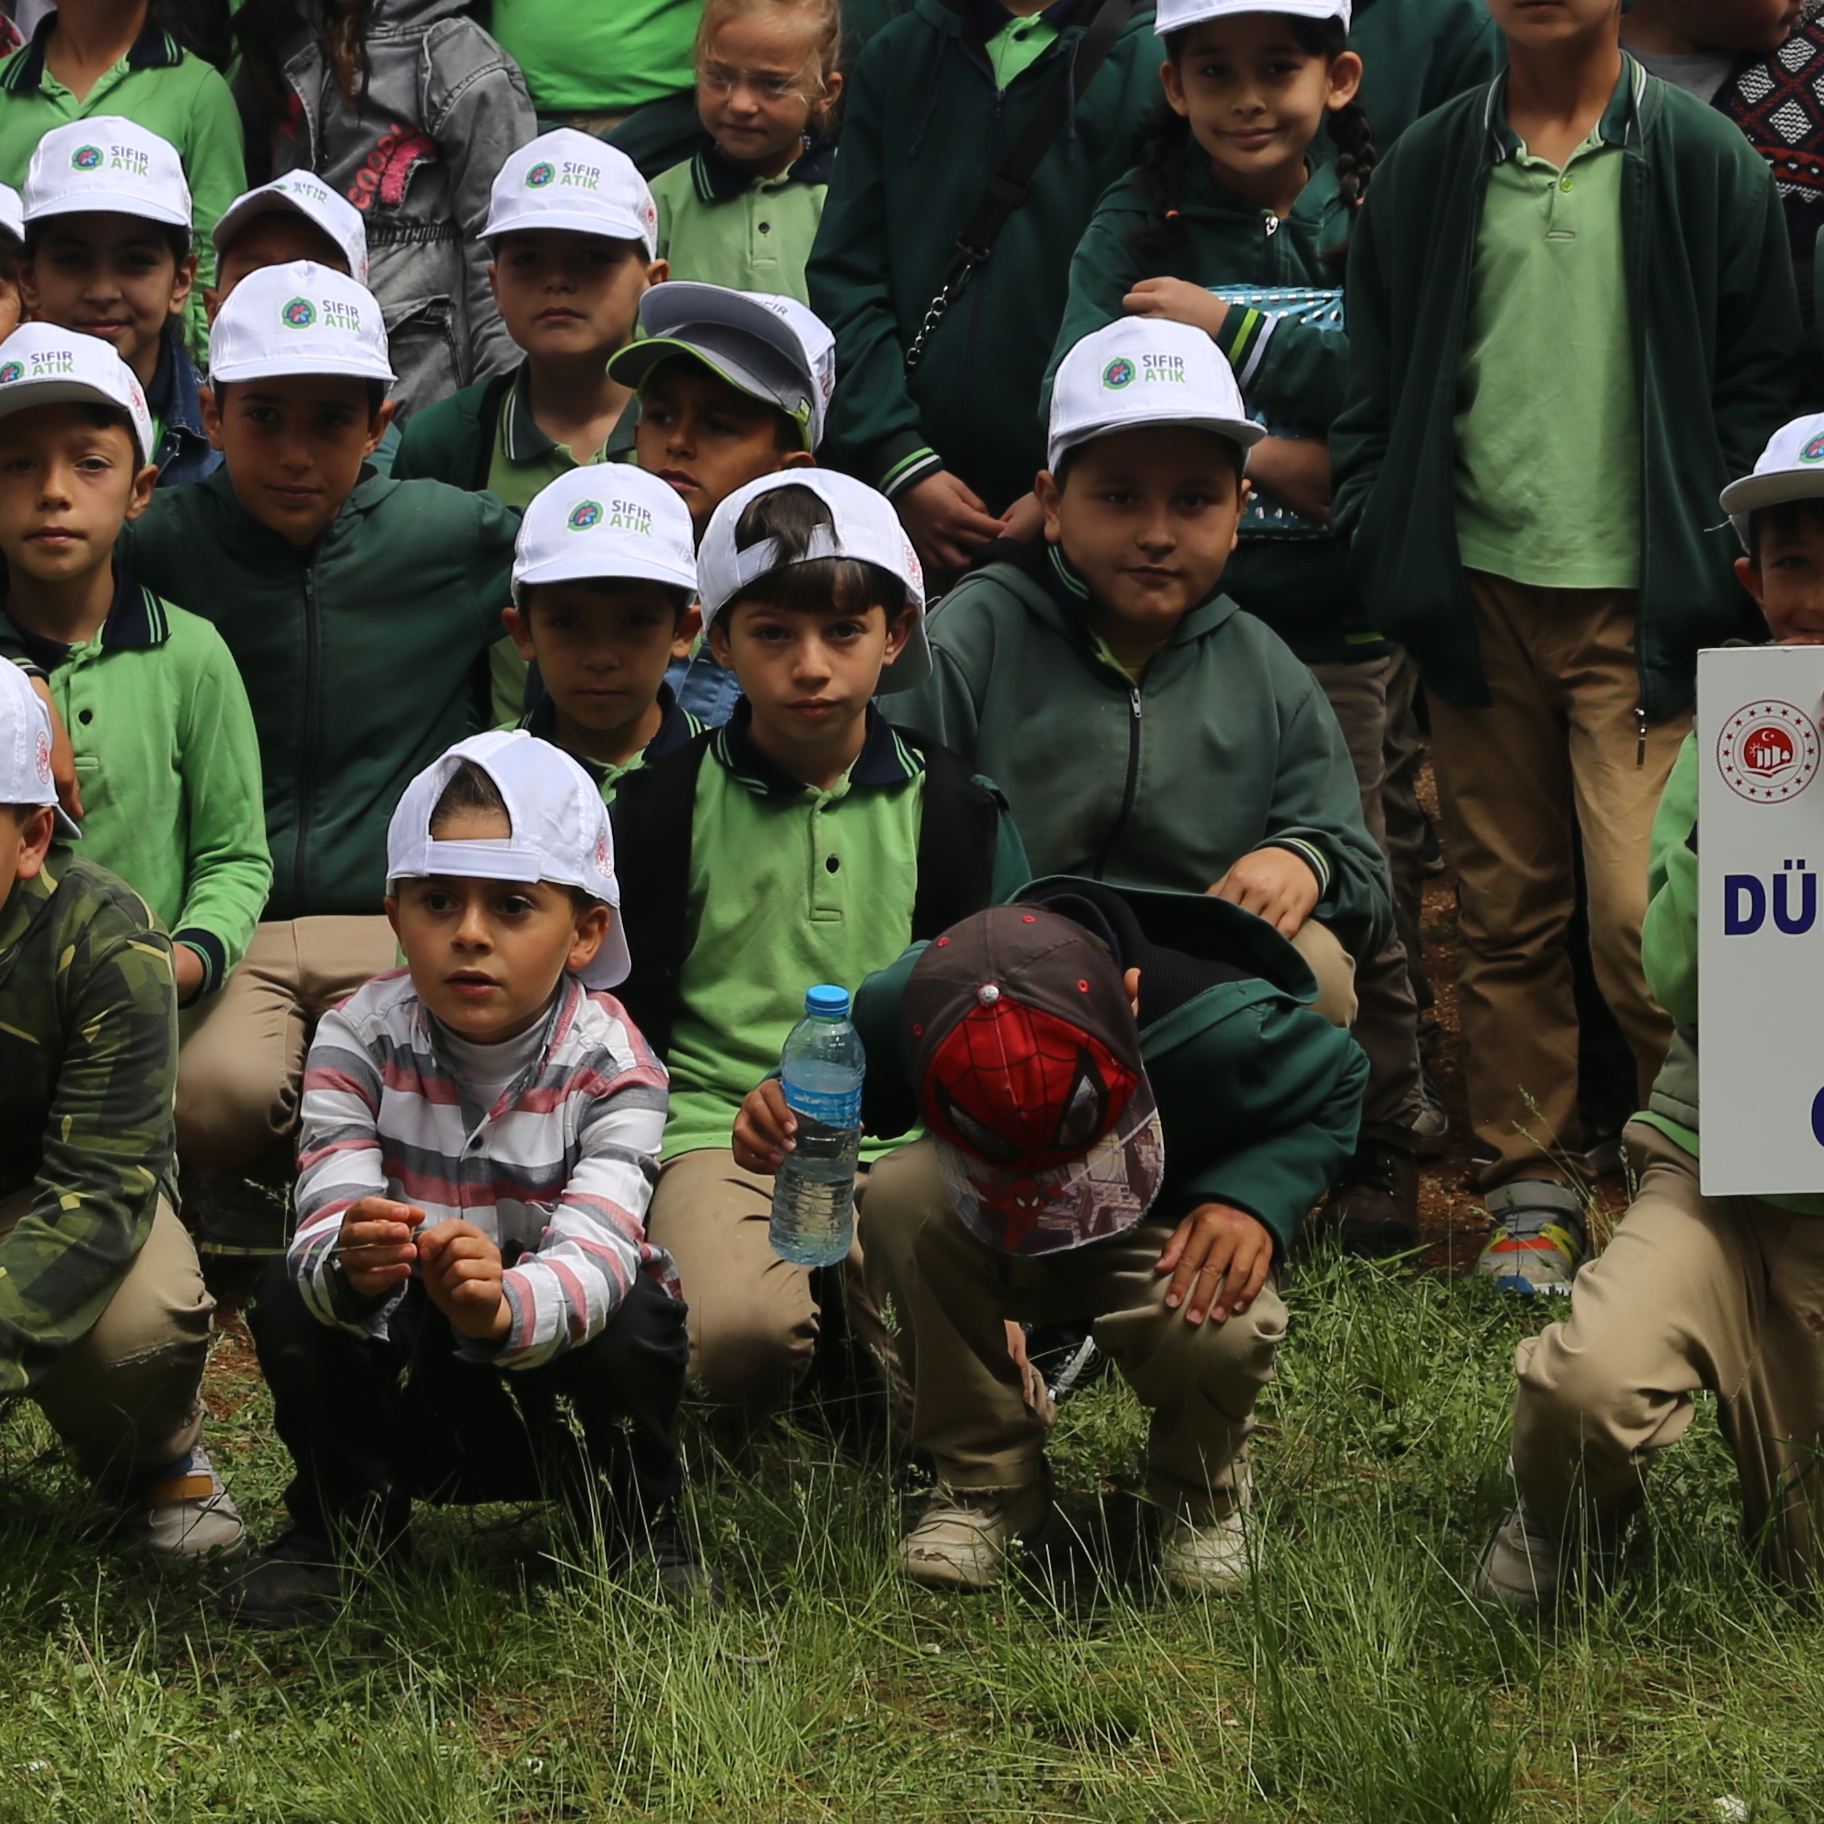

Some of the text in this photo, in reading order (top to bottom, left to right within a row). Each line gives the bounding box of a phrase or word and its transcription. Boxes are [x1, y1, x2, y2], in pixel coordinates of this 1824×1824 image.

[111, 145, 149, 164] SIFIR
[111, 158, 149, 176] ATIK
[563, 161, 600, 178] SIFIR
[562, 174, 598, 191] ATIK
[323, 300, 359, 318] SIFIR
[325, 314, 362, 333] ATIK
[31, 351, 72, 364] SIFIR
[1143, 354, 1184, 369] SIFIR
[33, 362, 74, 376] ATIK
[1145, 368, 1185, 382] ATIK
[612, 500, 652, 522] SIFIR
[610, 513, 652, 536] ATIK
